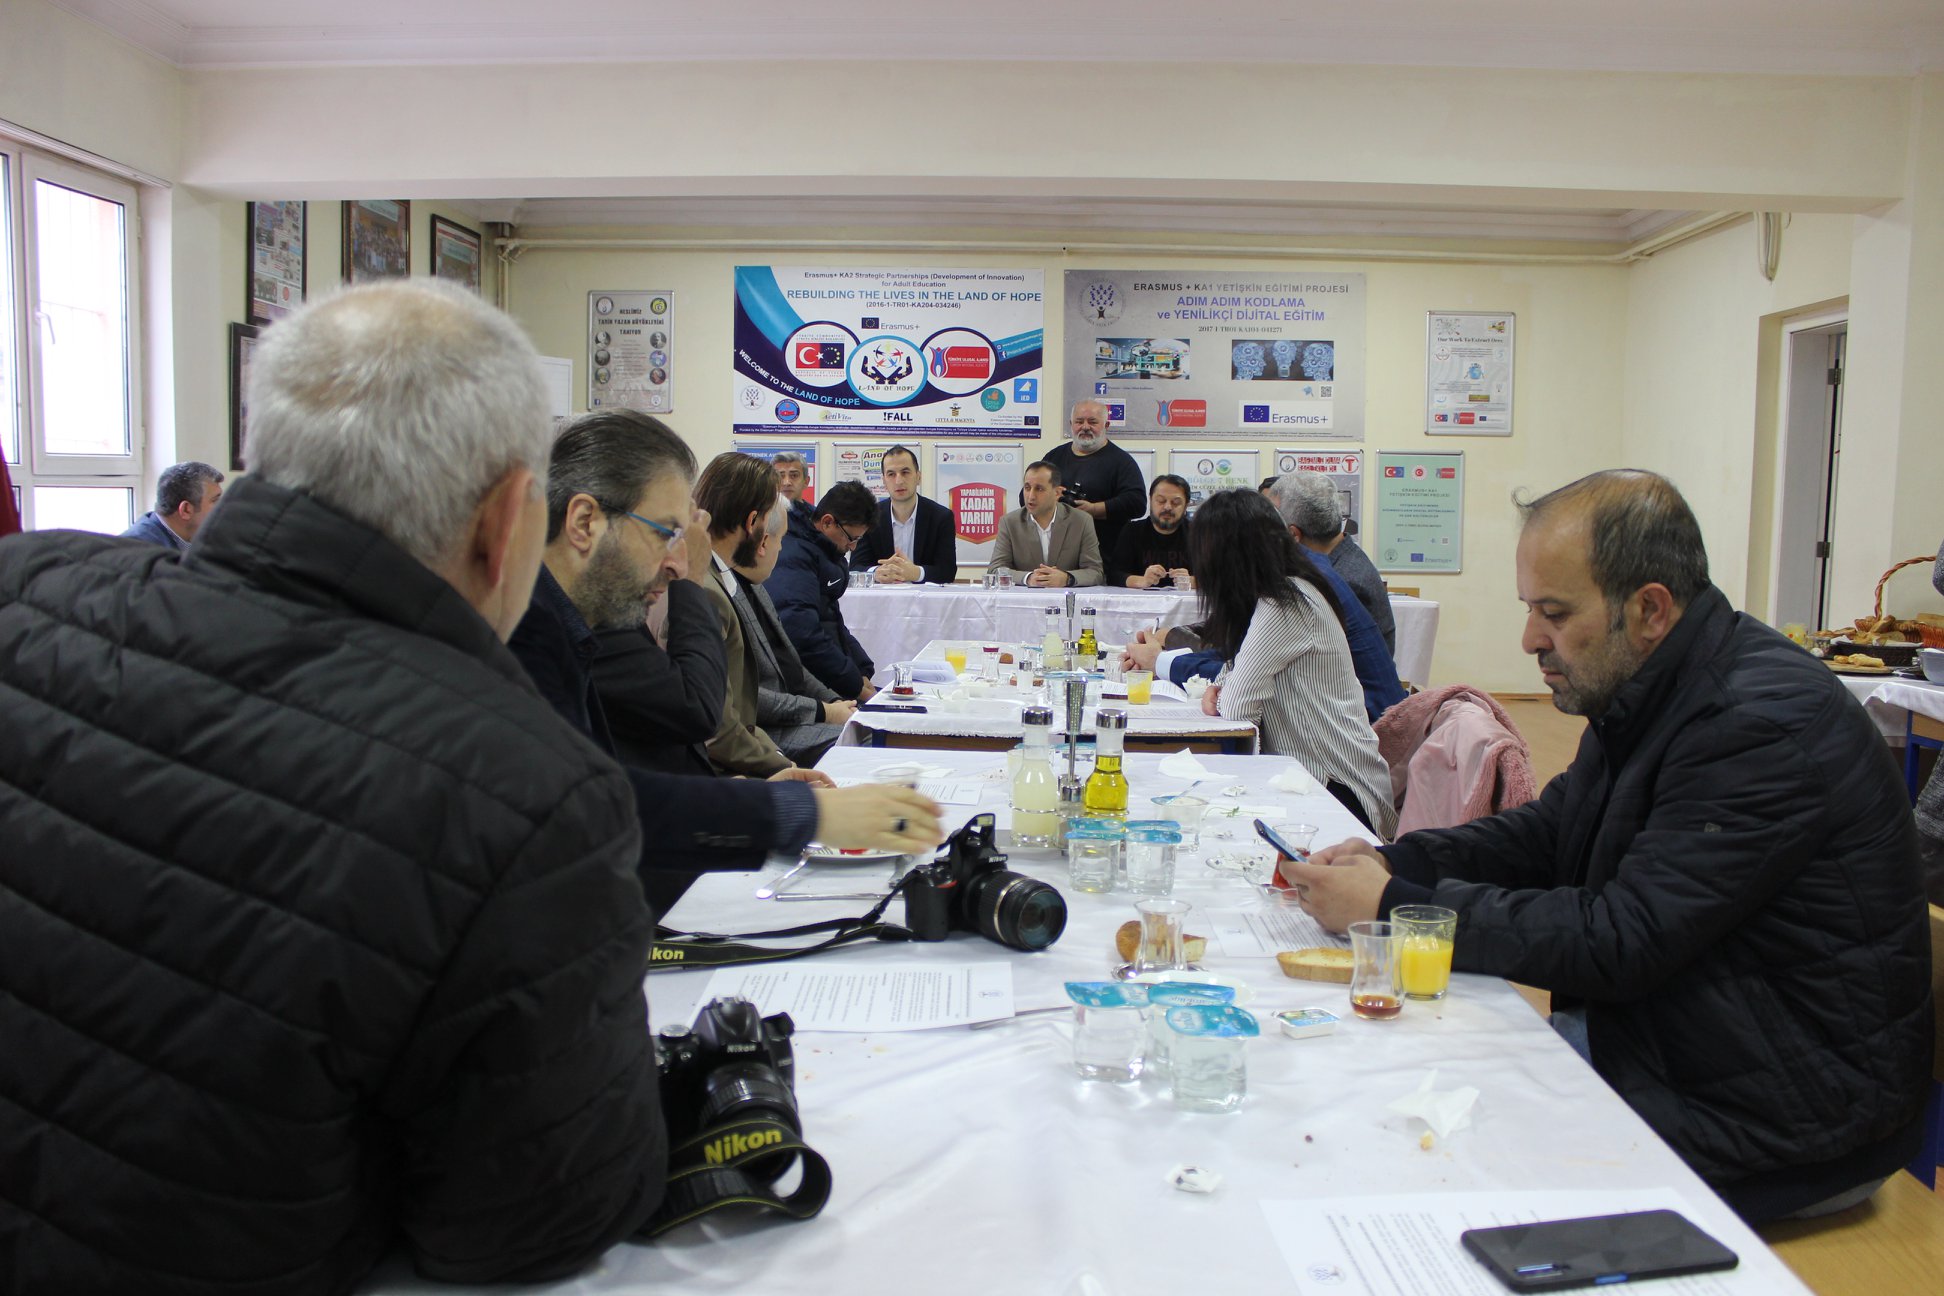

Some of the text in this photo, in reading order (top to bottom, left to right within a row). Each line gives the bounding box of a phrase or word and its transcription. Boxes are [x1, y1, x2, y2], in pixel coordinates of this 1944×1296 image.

[886, 273, 928, 281] Partnerships
[930, 273, 977, 281] (Development
[986, 274, 1025, 282] Innovation)
[1134, 283, 1183, 291] ERASMUS
[1216, 283, 1262, 293] YETİŞKİN
[1265, 283, 1303, 293] EĞİTİMİ
[1305, 284, 1349, 293] PROJESİ
[787, 290, 1042, 302] REBUILDING THE LIVES IN THE LAND OF HOPE
[1177, 296, 1305, 307] ADIM ADIM KODLAMA
[1157, 308, 1325, 321] ve YENİLİKÇİ DİJİTAL EĞİTİM
[739, 349, 860, 406] WELCOME TO THE LAND OF HOPE
[1272, 413, 1329, 424] Erasmus+
[960, 497, 995, 511] KADAR
[960, 511, 994, 524] VARIM
[960, 525, 994, 534] PROJESİ
[727, 1044, 757, 1053] Nikon
[704, 1128, 782, 1165] Nikon
